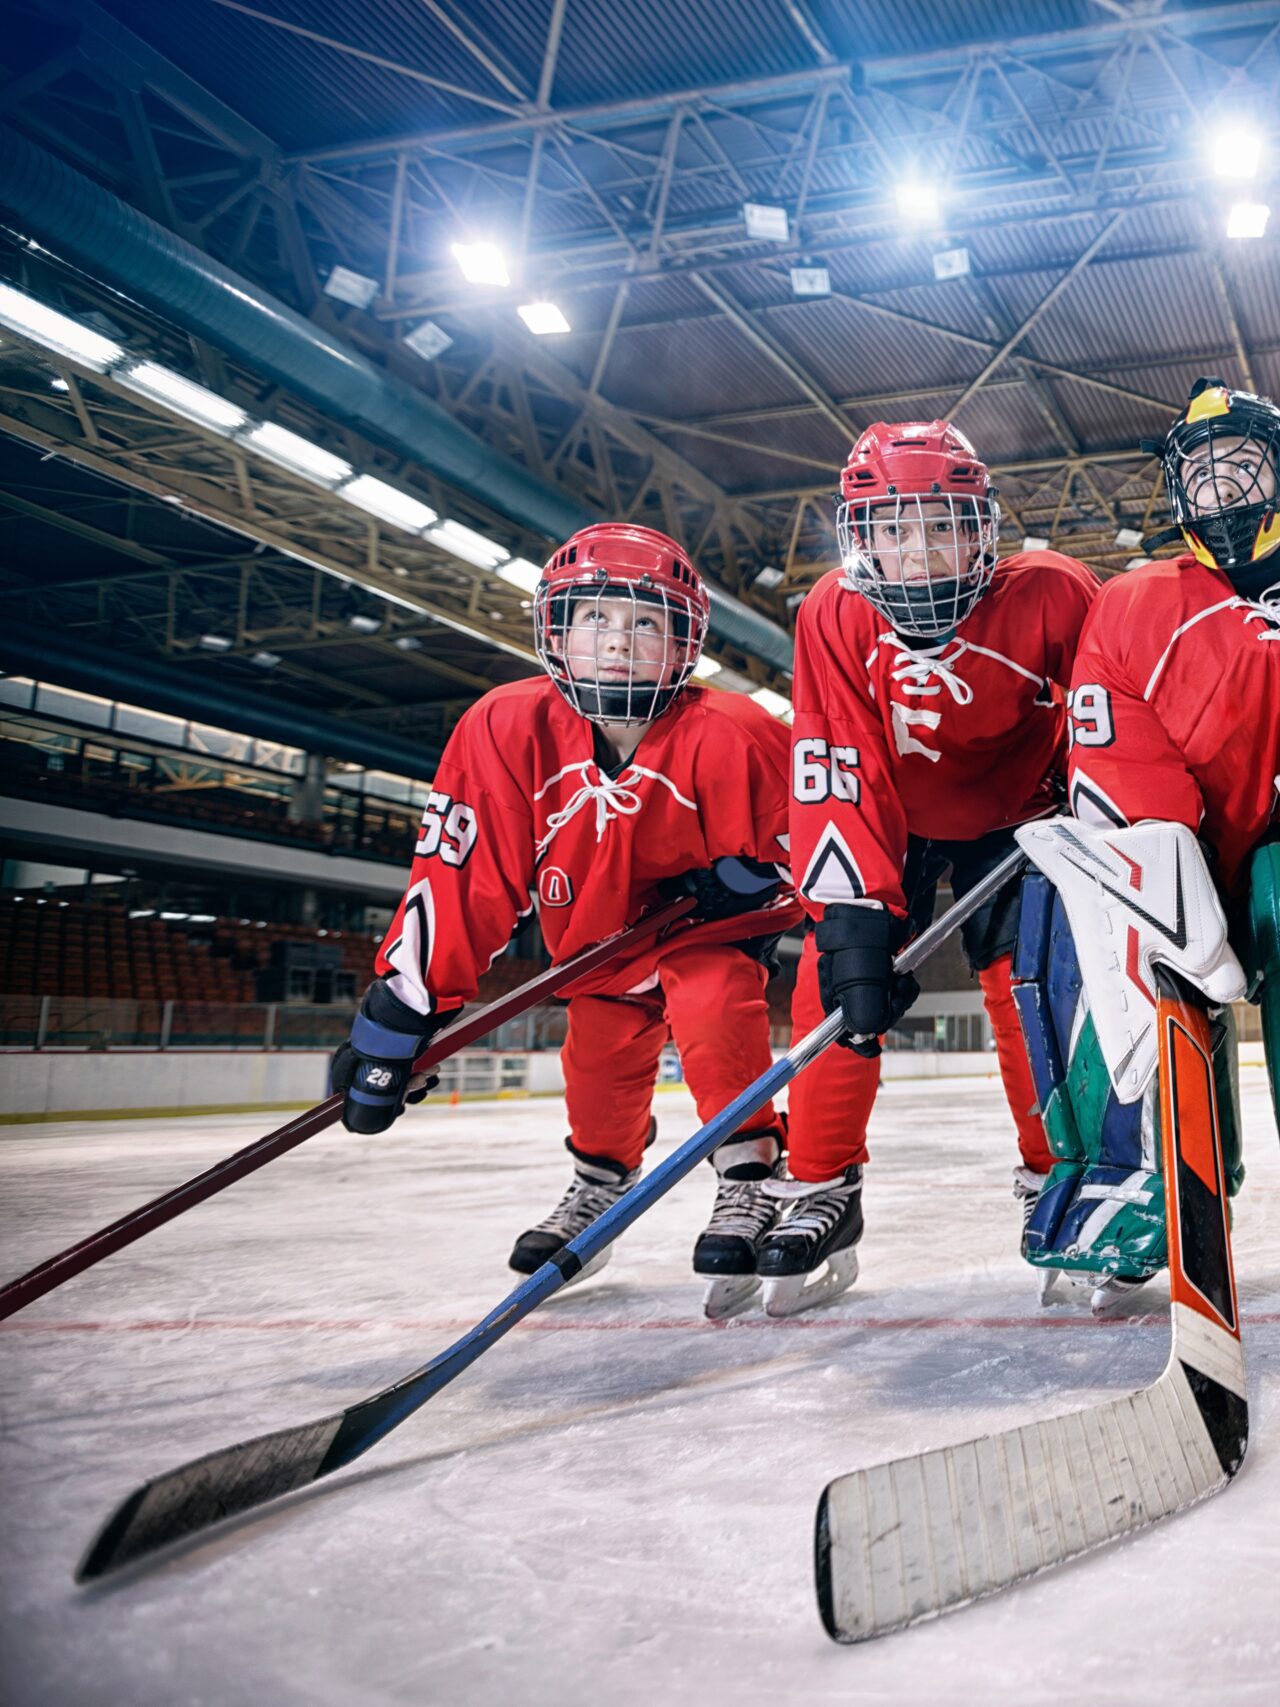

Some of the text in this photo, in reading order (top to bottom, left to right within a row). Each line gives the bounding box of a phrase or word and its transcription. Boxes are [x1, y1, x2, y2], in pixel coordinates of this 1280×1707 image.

[792, 738, 860, 806] 66
[415, 791, 478, 870] 59
[366, 1067, 393, 1087] 28
